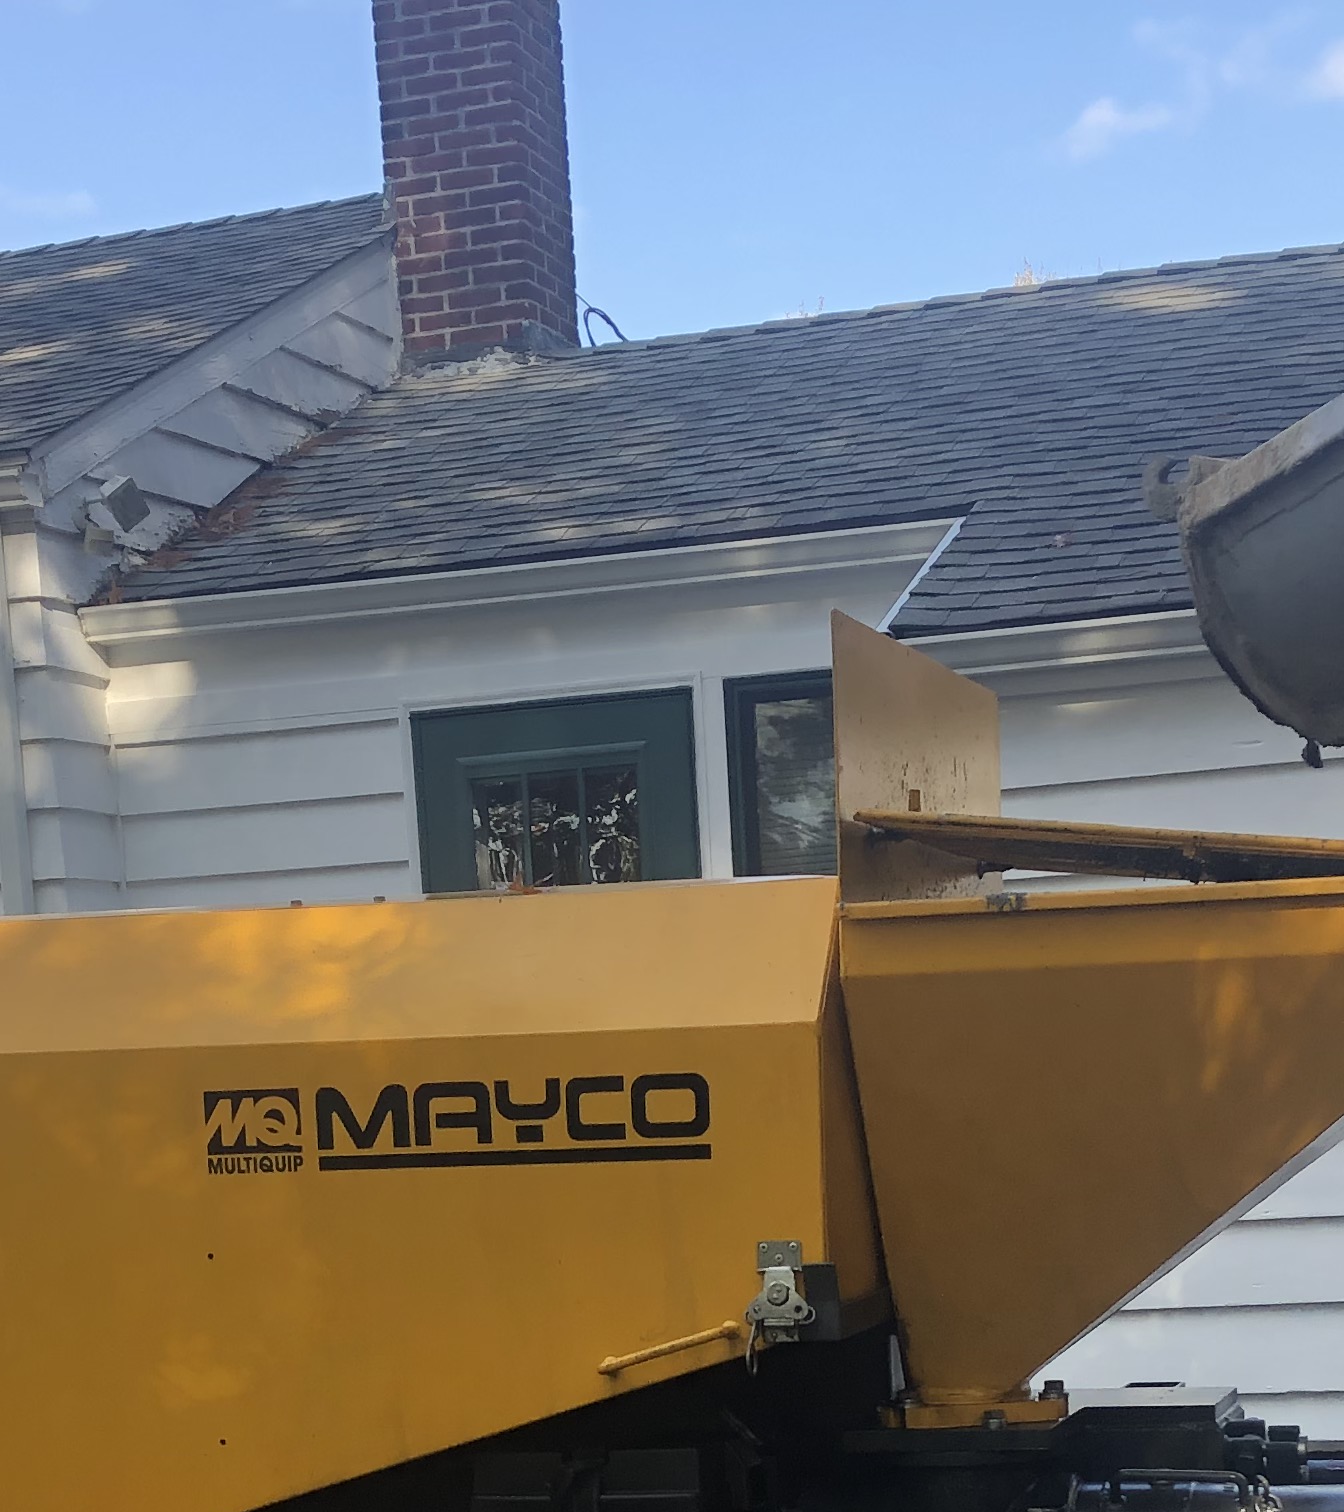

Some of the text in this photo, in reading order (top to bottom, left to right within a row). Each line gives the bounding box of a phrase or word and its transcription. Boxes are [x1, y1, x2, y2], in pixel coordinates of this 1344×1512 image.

[204, 1088, 303, 1154] MQ
[315, 1072, 711, 1151] MAYCO
[207, 1155, 303, 1175] MULTIQUIP
